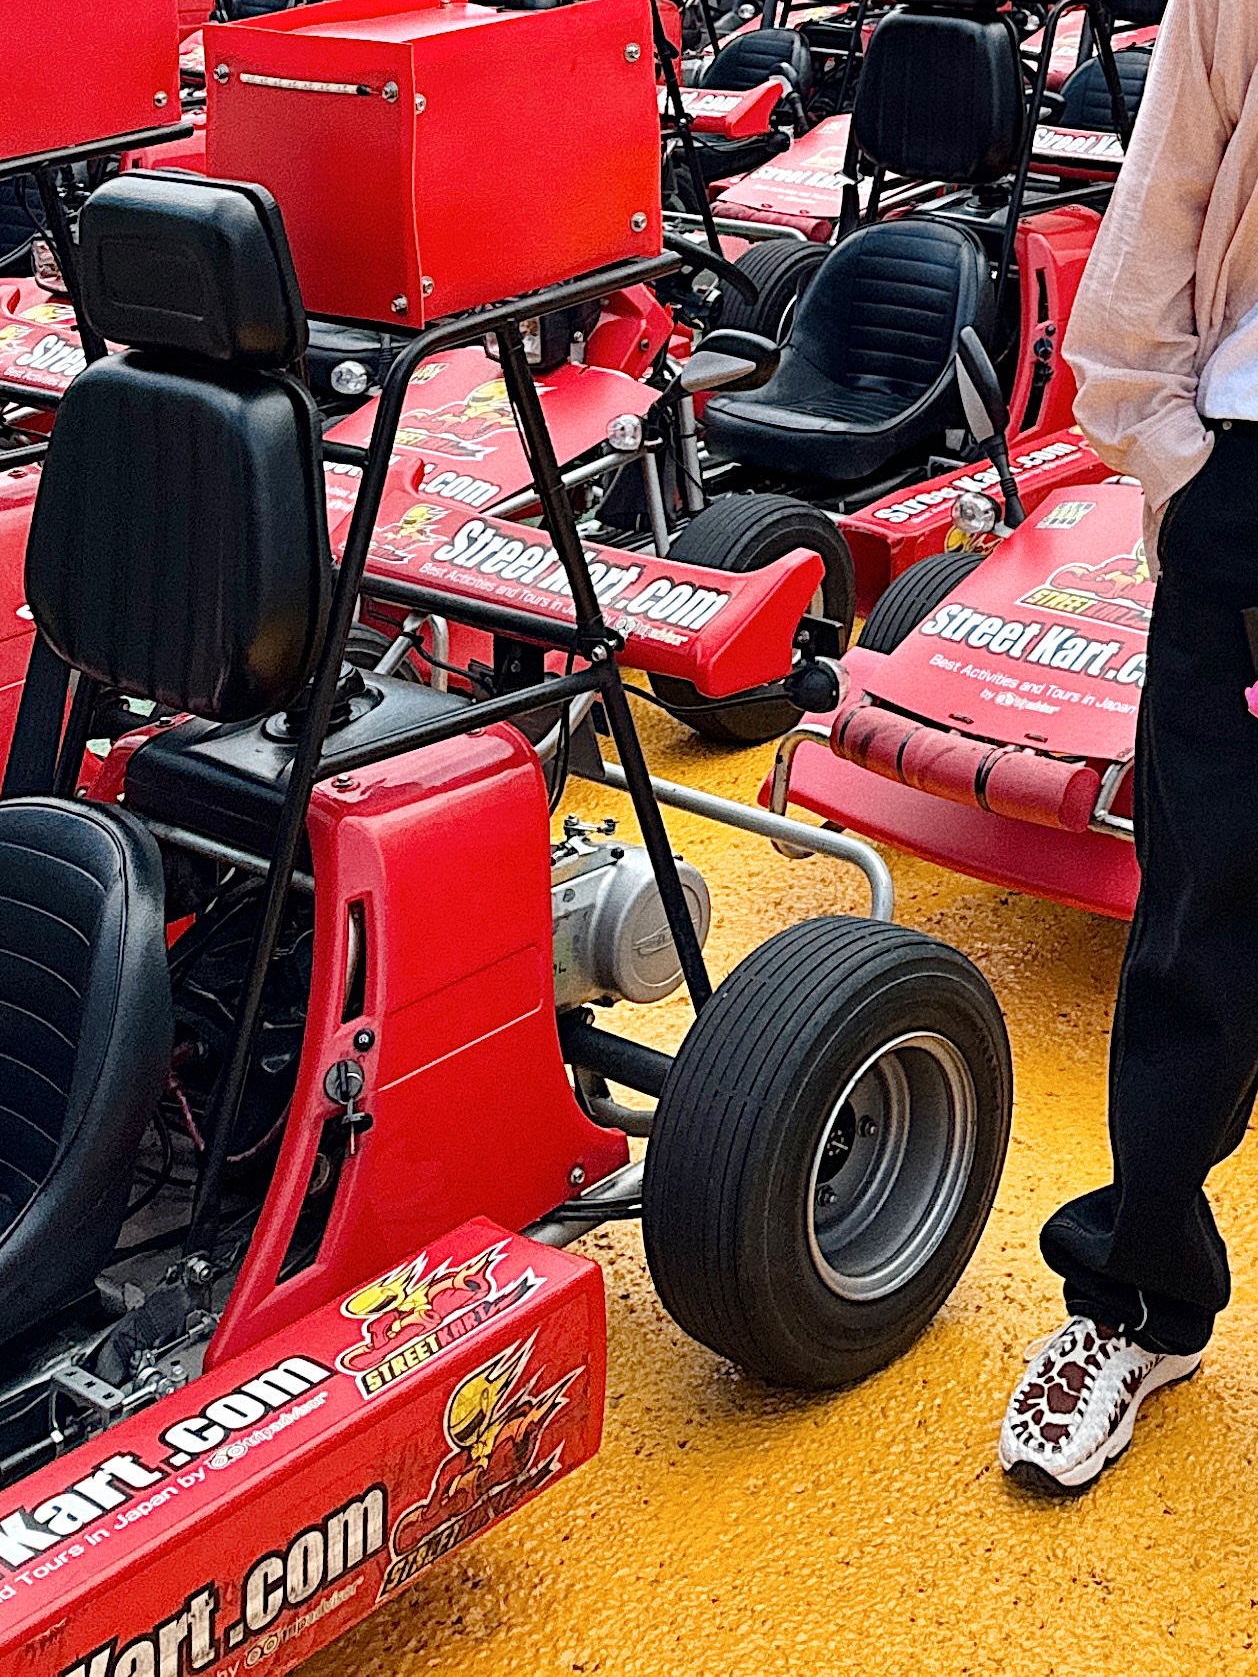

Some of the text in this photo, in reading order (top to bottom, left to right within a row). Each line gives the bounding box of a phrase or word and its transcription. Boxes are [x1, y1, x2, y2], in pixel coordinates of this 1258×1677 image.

[434, 517, 559, 585] Street
[920, 603, 1149, 687] Street Kart.c
[929, 653, 1137, 716] Best Activities and Tours in Japan
[14, 1544, 85, 1586] Tours
[114, 1487, 178, 1530] Japan
[177, 1467, 206, 1489] by
